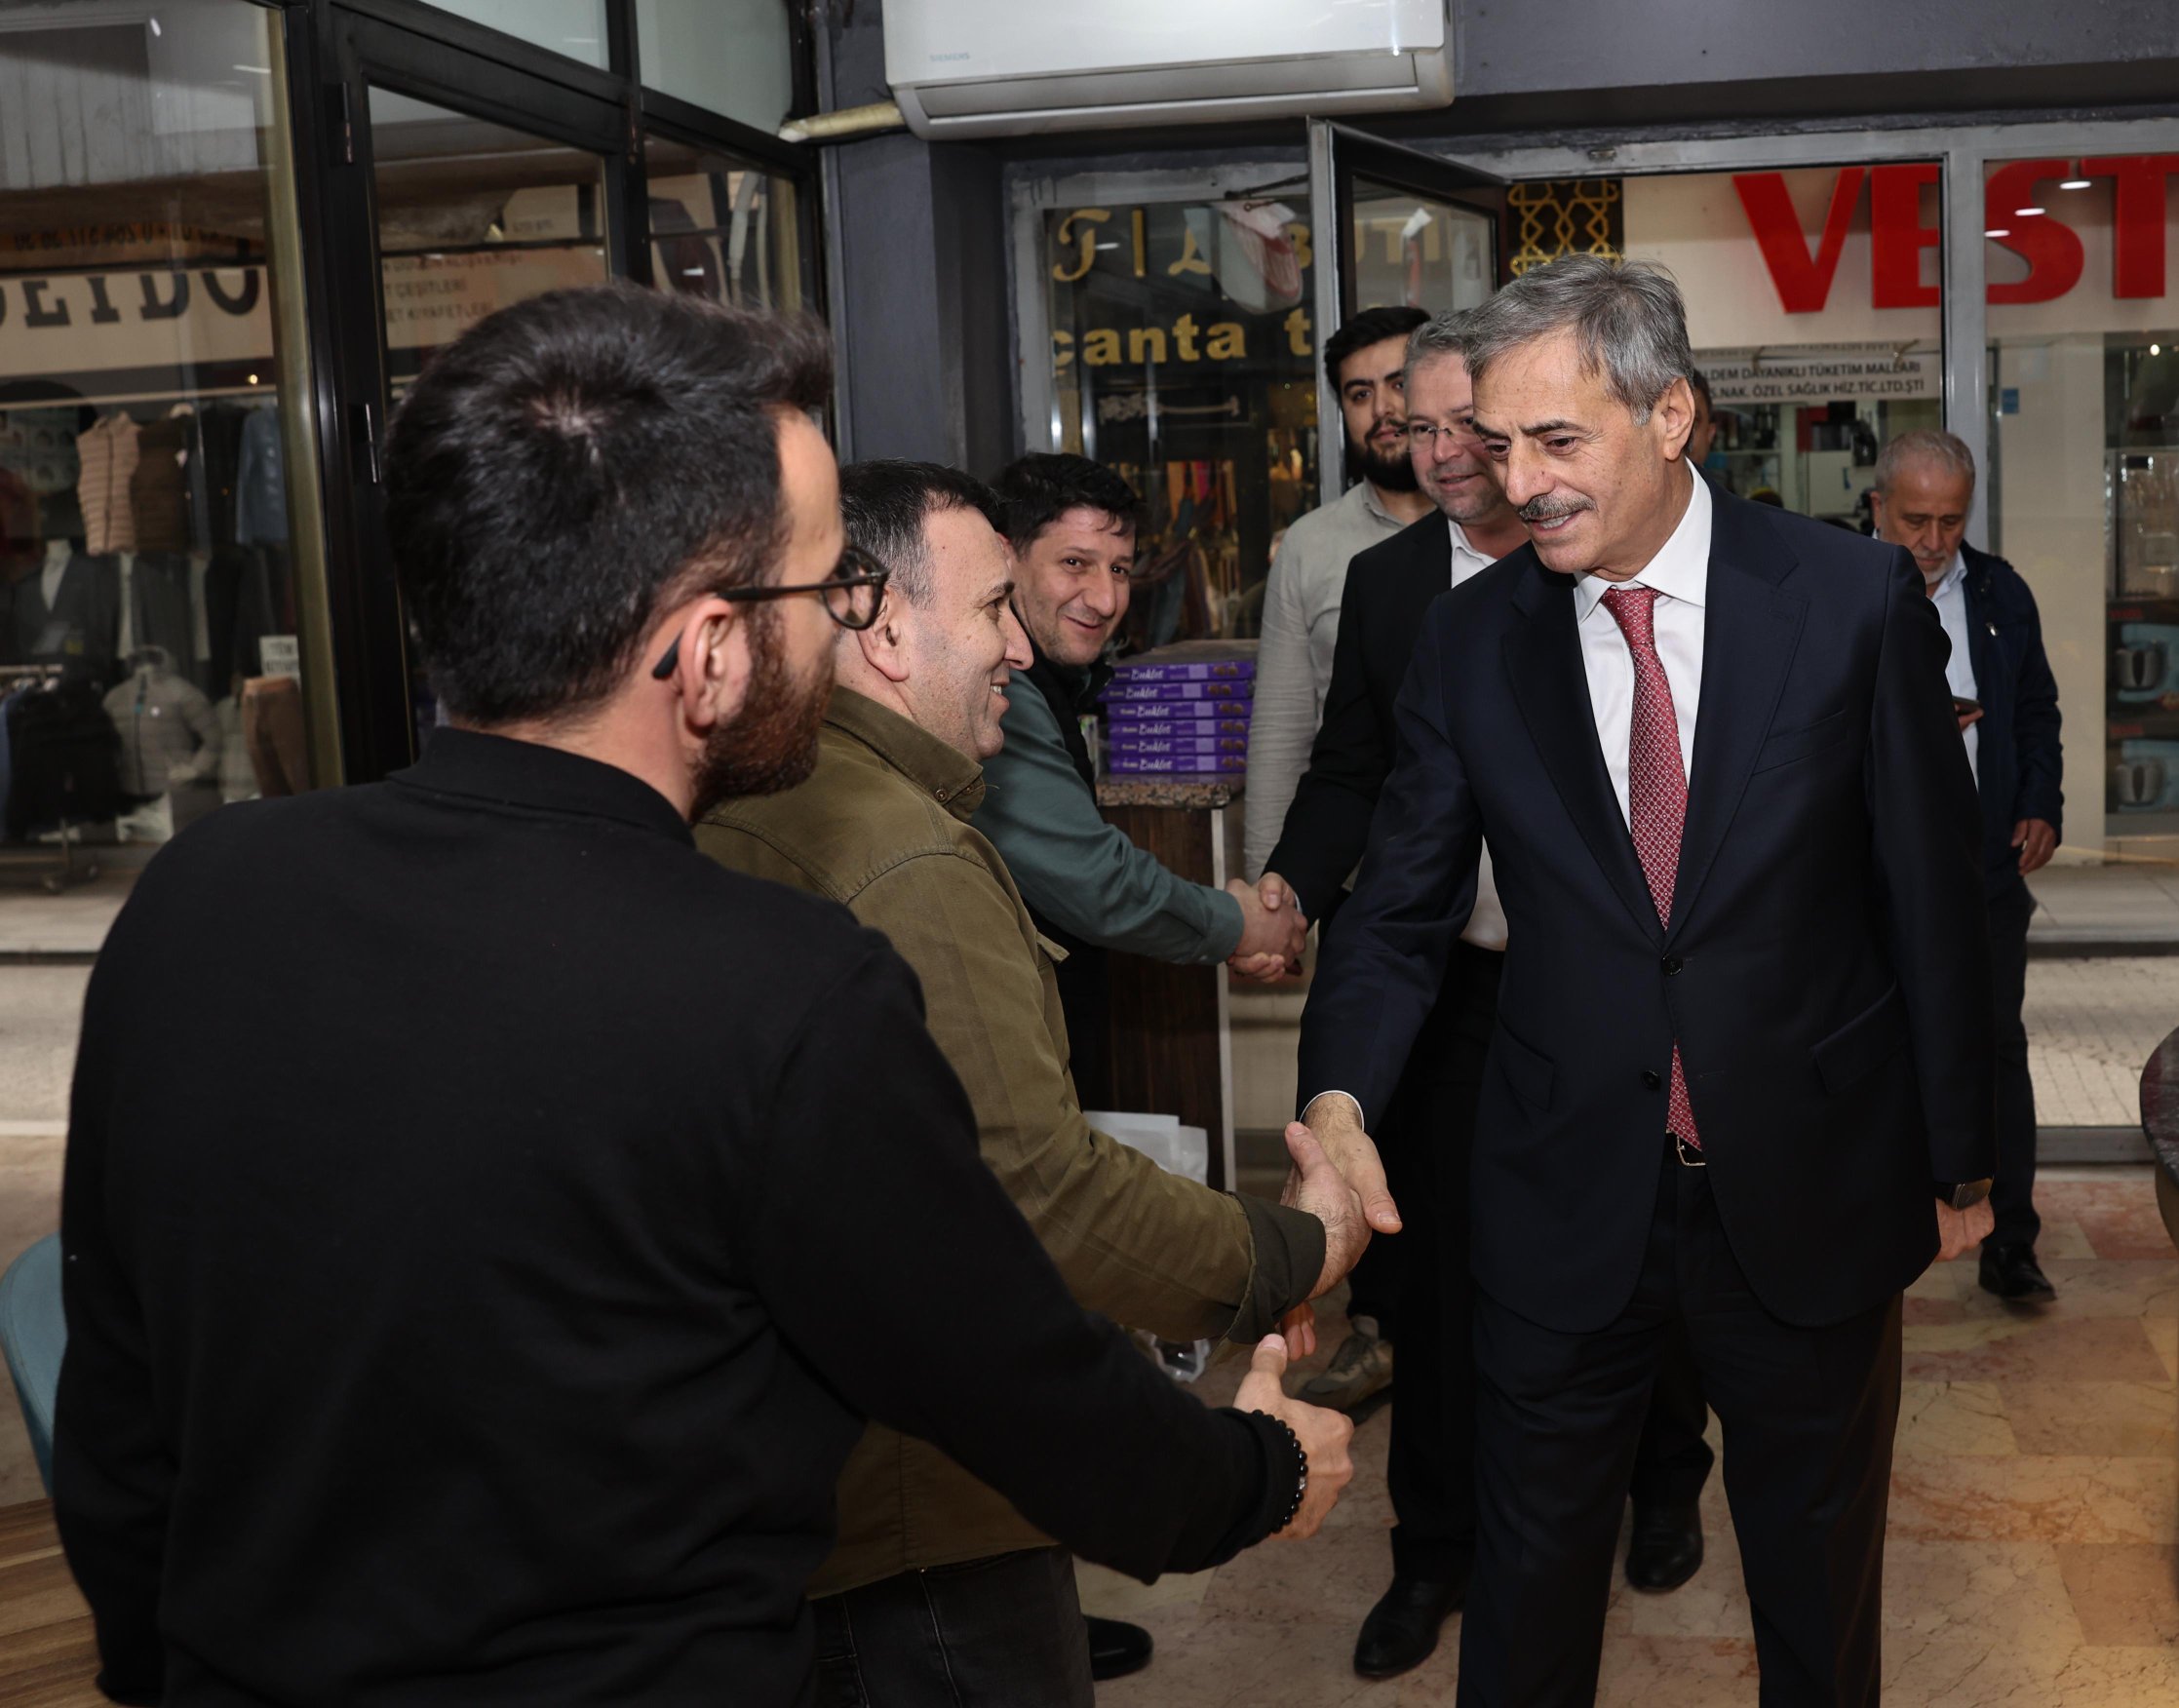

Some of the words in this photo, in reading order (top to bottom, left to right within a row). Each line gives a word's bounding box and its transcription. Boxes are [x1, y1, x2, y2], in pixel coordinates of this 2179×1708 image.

[1702, 368, 1738, 381] LDEM
[1809, 361, 1863, 376] TÜKETİM
[1752, 383, 1783, 398] ÖZEL
[1788, 380, 1830, 396] SAĞLIK
